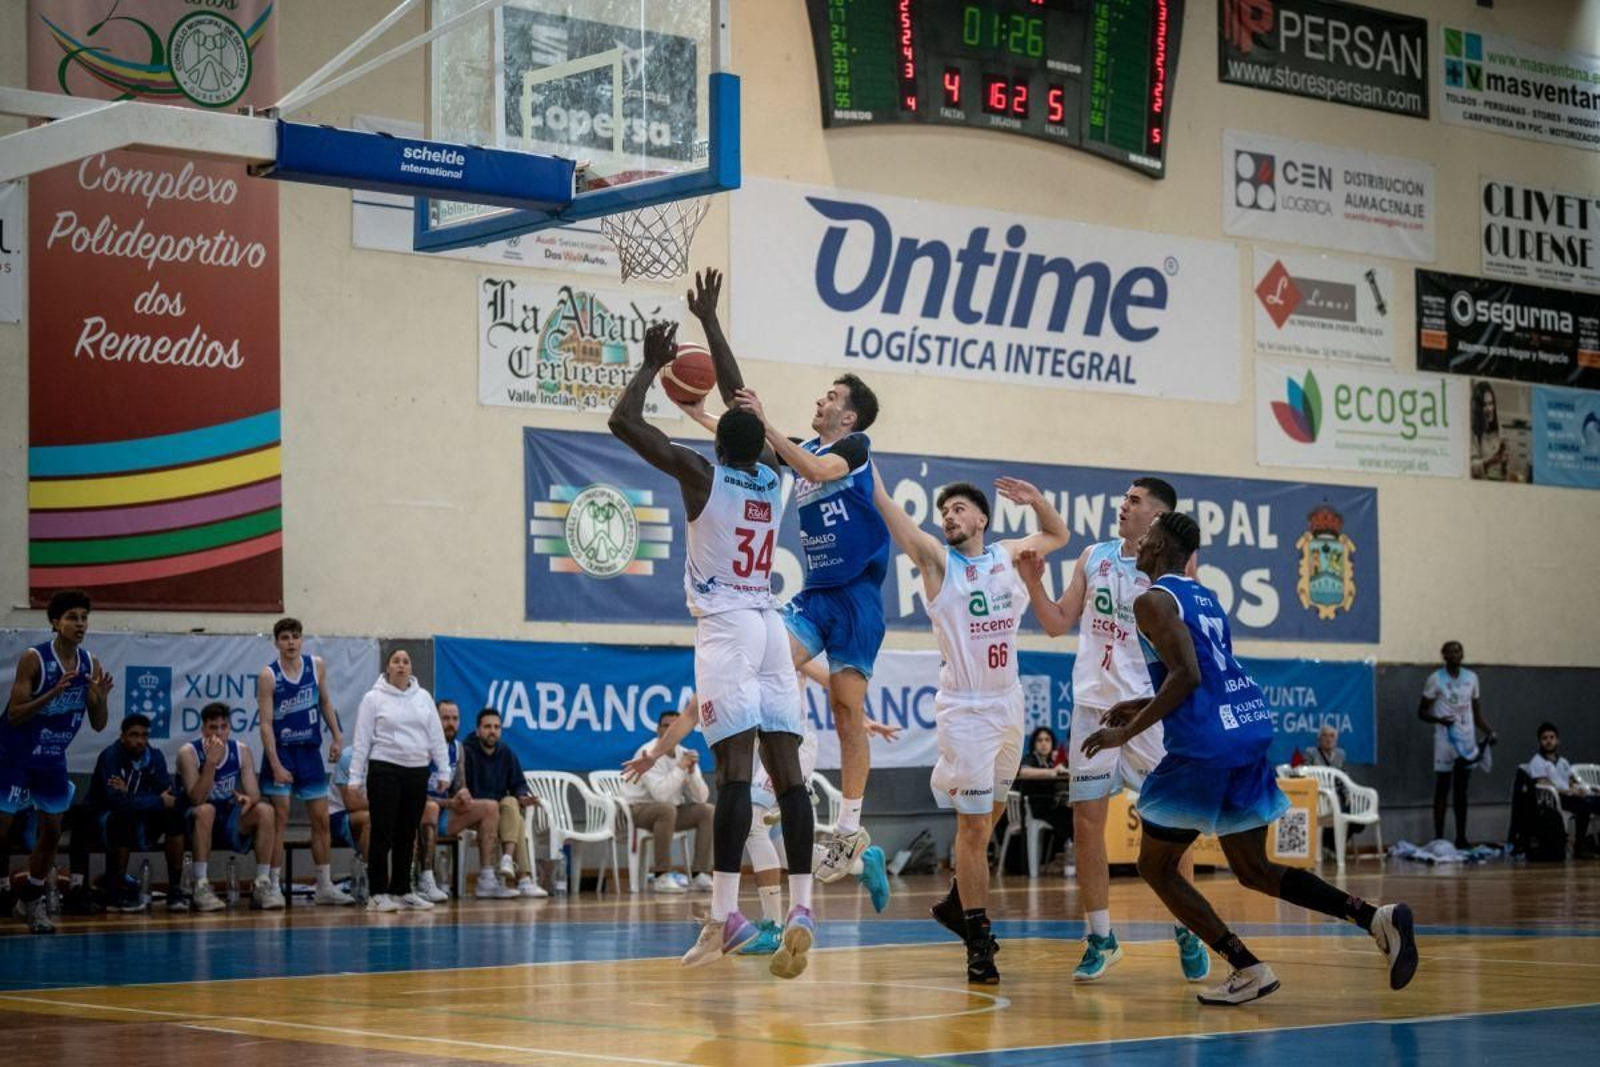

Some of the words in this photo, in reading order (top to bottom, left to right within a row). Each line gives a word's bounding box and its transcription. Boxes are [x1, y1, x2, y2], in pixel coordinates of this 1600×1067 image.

[964, 7, 1043, 57] 01:26
[1279, 10, 1421, 79] PERSAN
[944, 73, 960, 102] 4
[1012, 86, 1028, 112] 2
[1228, 59, 1421, 111] www.storespersan.com
[1048, 89, 1064, 122] 5
[1445, 92, 1477, 106] TOLDOS
[1483, 100, 1526, 115] PERSIANAS
[1532, 110, 1562, 123] STORES
[1516, 121, 1527, 131] EN
[1527, 123, 1544, 134] PVC
[400, 162, 463, 180] international
[403, 145, 465, 167] schelde
[78, 153, 238, 209] Complexo
[1282, 160, 1333, 192] CEN
[1343, 170, 1424, 198] DISTRIBUCIÓN
[1344, 193, 1425, 218] ALMACENAJE
[1483, 182, 1592, 230] CLIVET
[47, 211, 266, 271] Polideportivo
[544, 249, 561, 261] Das
[1484, 223, 1594, 270] OURENSE
[805, 196, 1168, 343] Ontime
[133, 281, 186, 317] dos
[484, 278, 540, 348] La
[1475, 300, 1574, 333] segurma
[75, 316, 244, 368] Remedios
[844, 325, 997, 371] LOGÍSTICA
[1004, 342, 1137, 385] INTEGRAL
[1509, 347, 1531, 362] Hogar
[1538, 351, 1570, 365] Negocio
[507, 388, 537, 403] Valle
[584, 394, 598, 408] 43
[1334, 378, 1449, 440] ecogal
[1358, 457, 1430, 472] www.ecogal.es
[819, 498, 849, 528] 24
[732, 527, 774, 579] 34
[988, 642, 1009, 669] 66
[184, 674, 262, 699] XUNT
[1235, 699, 1266, 714] XUNTA
[1239, 714, 1252, 725] DE
